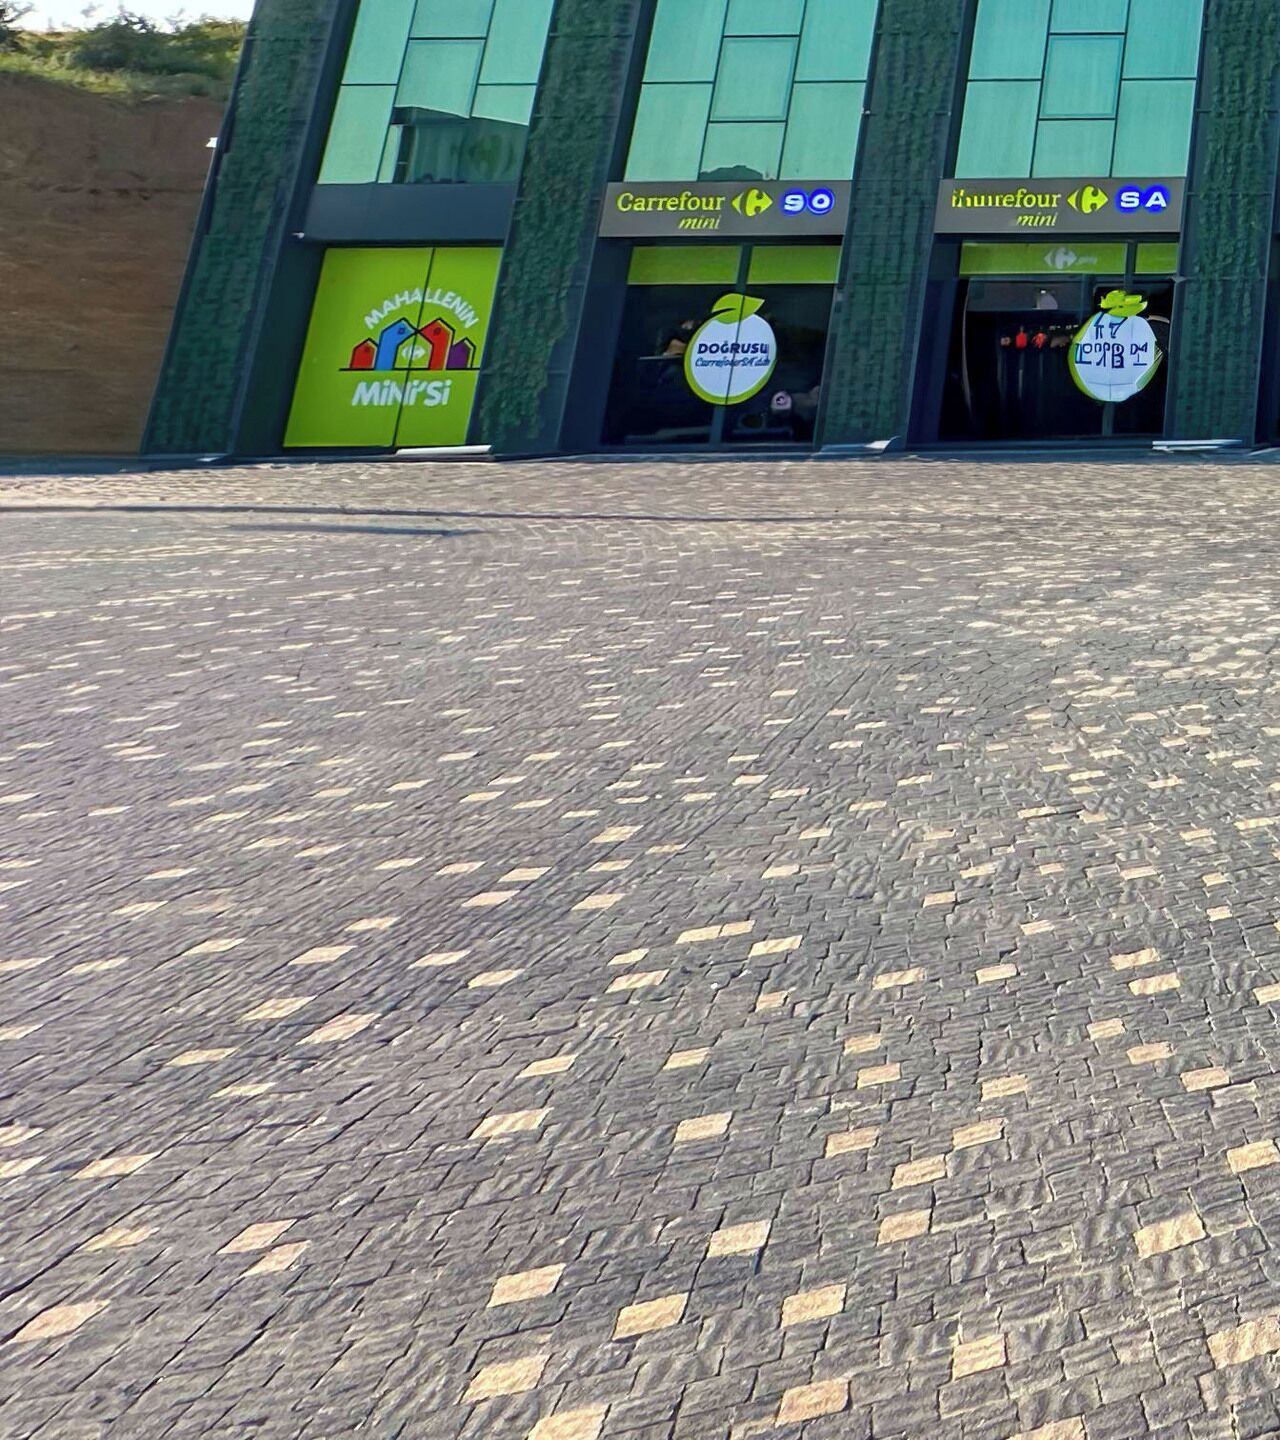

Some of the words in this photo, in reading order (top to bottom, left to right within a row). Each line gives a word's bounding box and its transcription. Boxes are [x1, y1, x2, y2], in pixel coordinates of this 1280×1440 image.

[616, 191, 726, 212] Carrefour
[1120, 191, 1167, 208] SA
[677, 214, 721, 230] mini
[1015, 212, 1058, 227] mini
